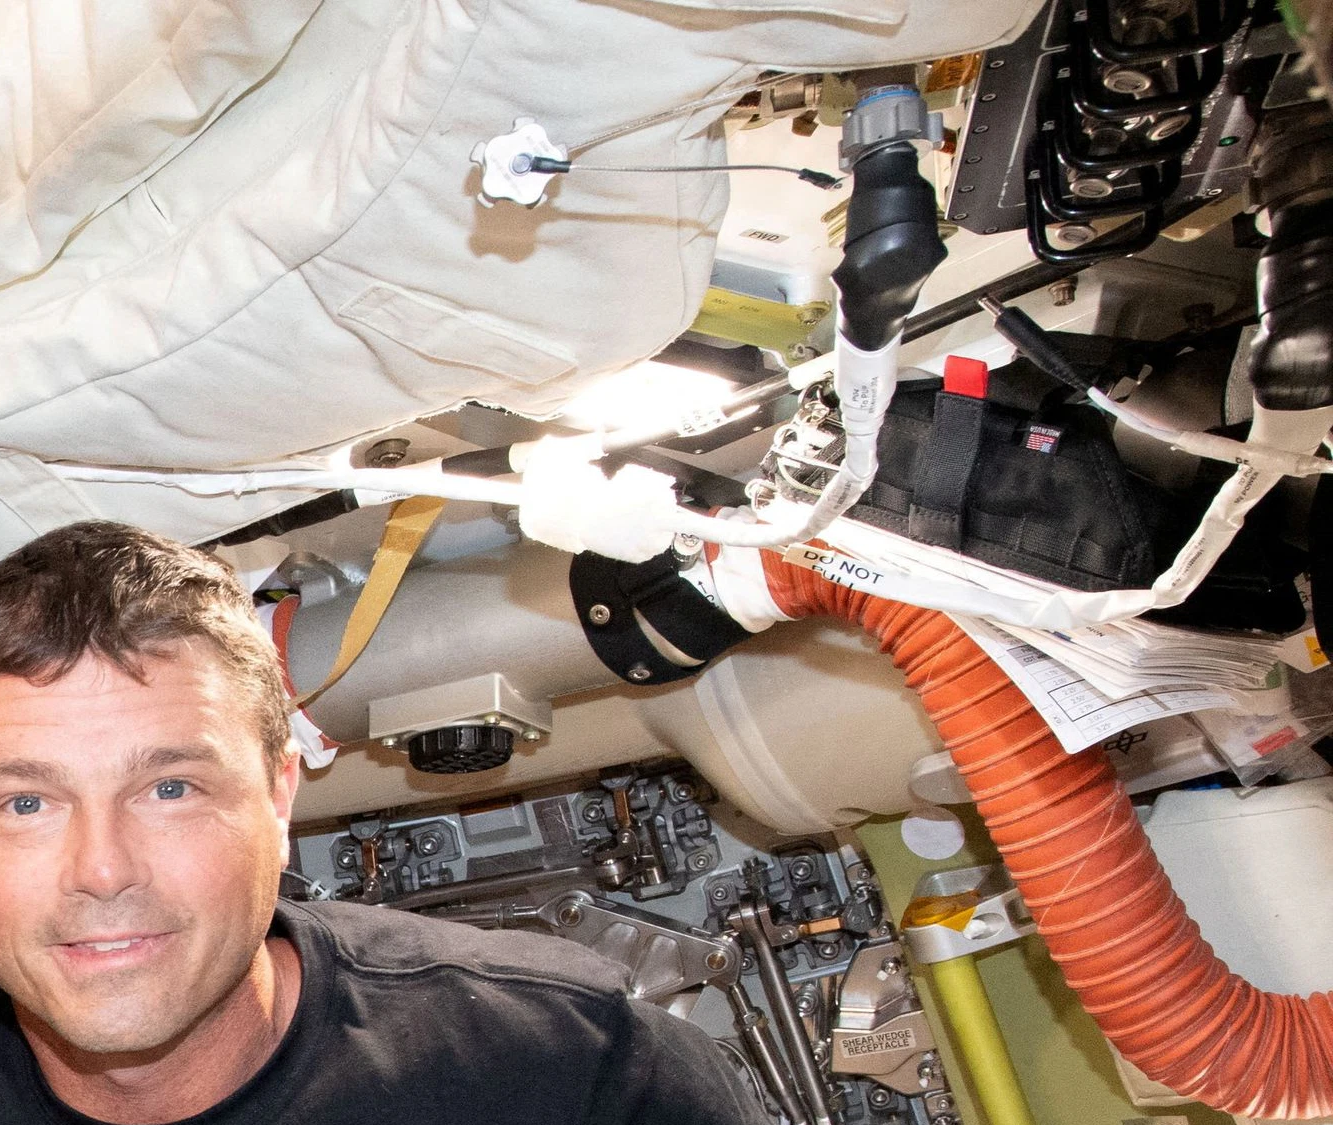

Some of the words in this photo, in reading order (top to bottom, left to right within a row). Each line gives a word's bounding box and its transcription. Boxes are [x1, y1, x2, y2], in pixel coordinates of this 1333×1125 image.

[748, 230, 780, 242] FWD
[803, 550, 834, 565] DO
[839, 560, 885, 584] NOT
[841, 1035, 874, 1049] SHEAR
[876, 1029, 912, 1042] WEDGE
[847, 1039, 910, 1056] RECEPTACLE
